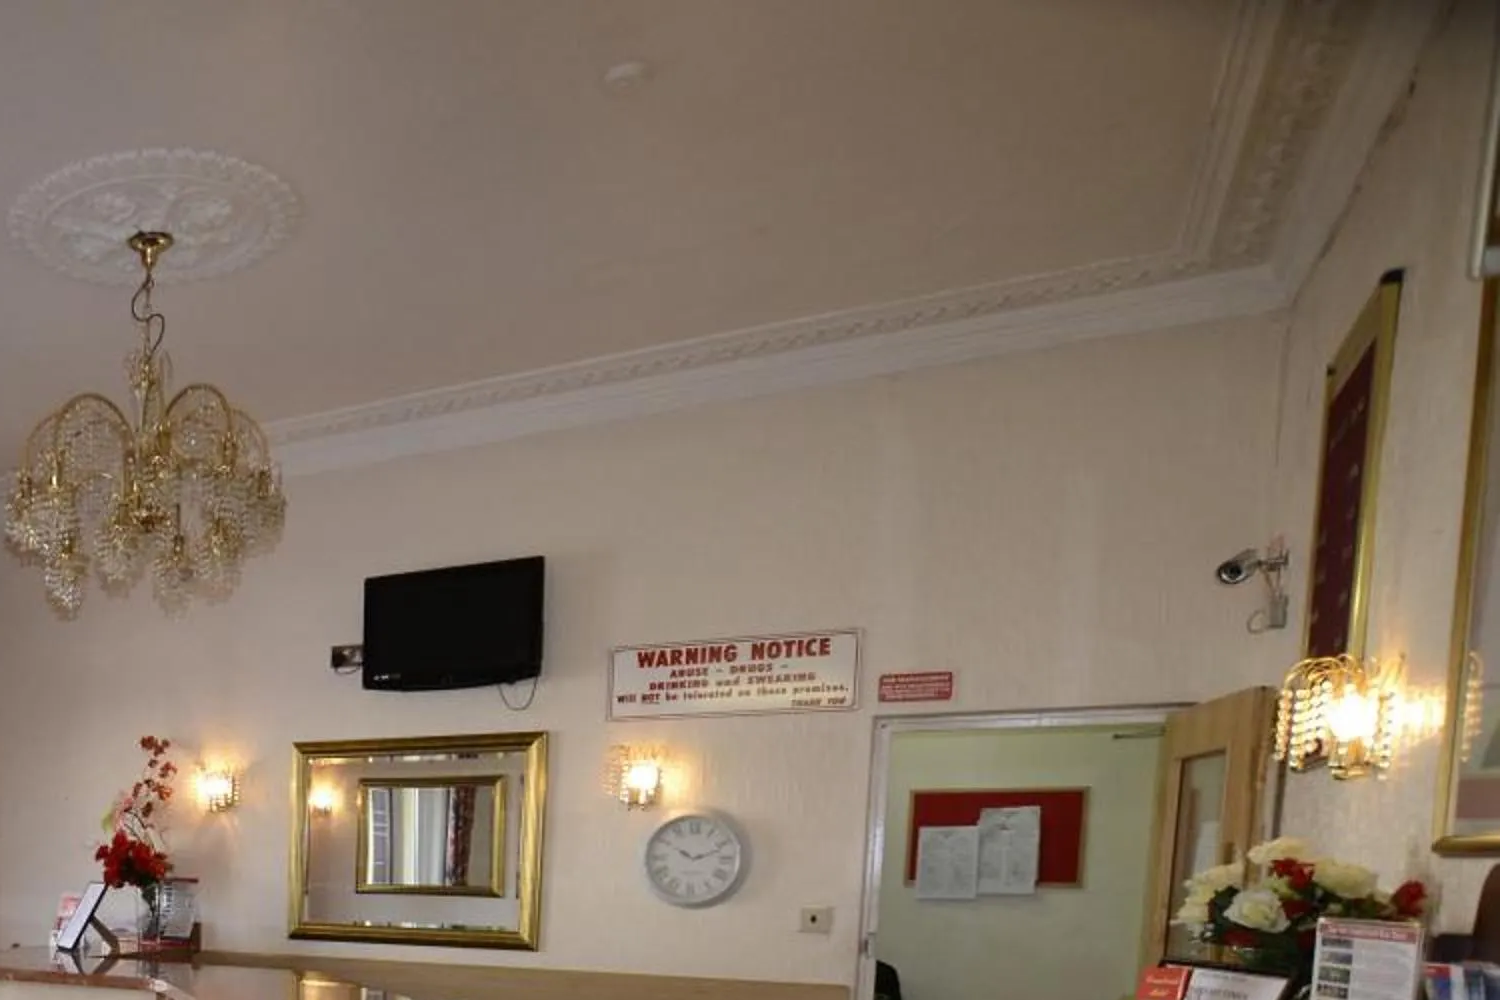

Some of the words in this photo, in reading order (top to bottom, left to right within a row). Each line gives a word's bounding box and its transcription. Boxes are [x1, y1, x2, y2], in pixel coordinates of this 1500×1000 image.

[637, 644, 737, 668] WARNING
[751, 638, 831, 661] NOTICE
[670, 667, 708, 678] ABUSE
[729, 663, 772, 674] DRUGS
[649, 680, 708, 690] DRINKING
[747, 672, 816, 685] SWEARING
[683, 688, 733, 700] tolerated
